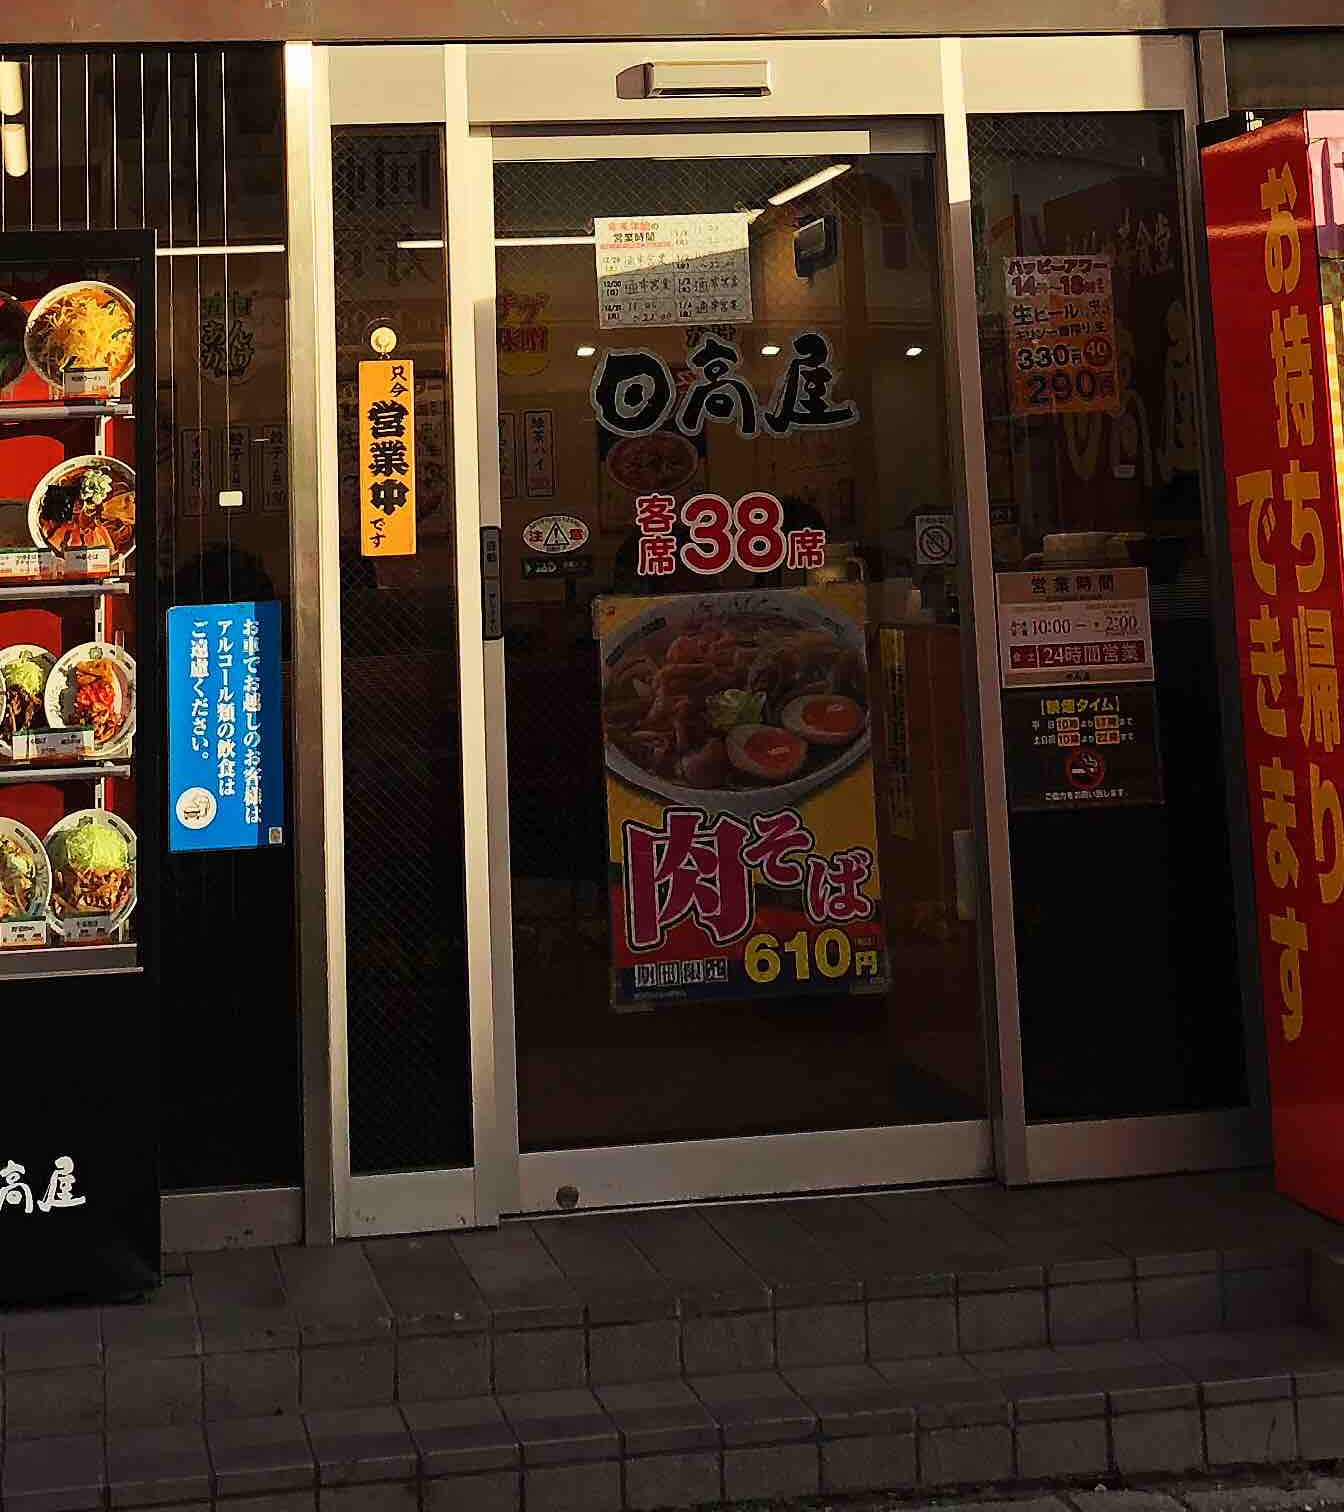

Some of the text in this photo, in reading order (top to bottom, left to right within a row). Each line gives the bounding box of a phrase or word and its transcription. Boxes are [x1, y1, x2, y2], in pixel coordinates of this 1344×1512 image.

[390, 365, 408, 397] 只今
[592, 328, 860, 438] 日高屋
[367, 399, 410, 516] 営業中
[369, 517, 386, 548] です
[636, 491, 826, 576] 客席 38 席
[1236, 469, 1311, 1042] できます
[622, 806, 875, 953] 肉そば
[744, 928, 879, 984] 610円
